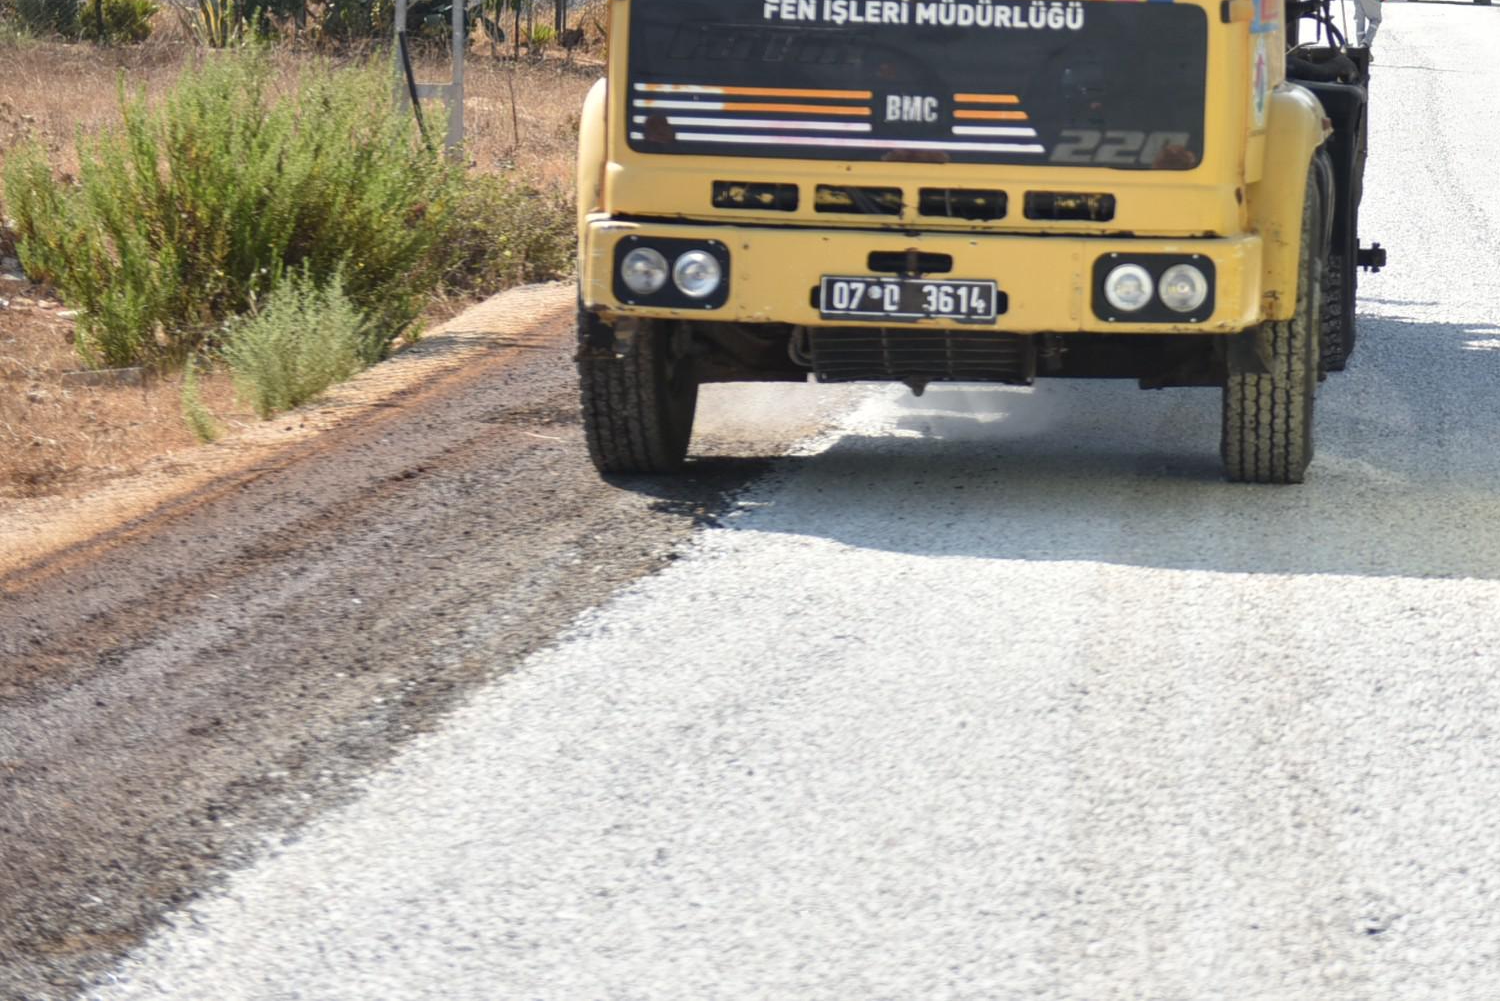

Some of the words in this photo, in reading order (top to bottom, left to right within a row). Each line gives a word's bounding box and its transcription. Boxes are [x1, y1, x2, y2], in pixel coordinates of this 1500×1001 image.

[885, 94, 938, 123] BMC
[831, 281, 866, 310] 07
[921, 284, 987, 314] 3614
